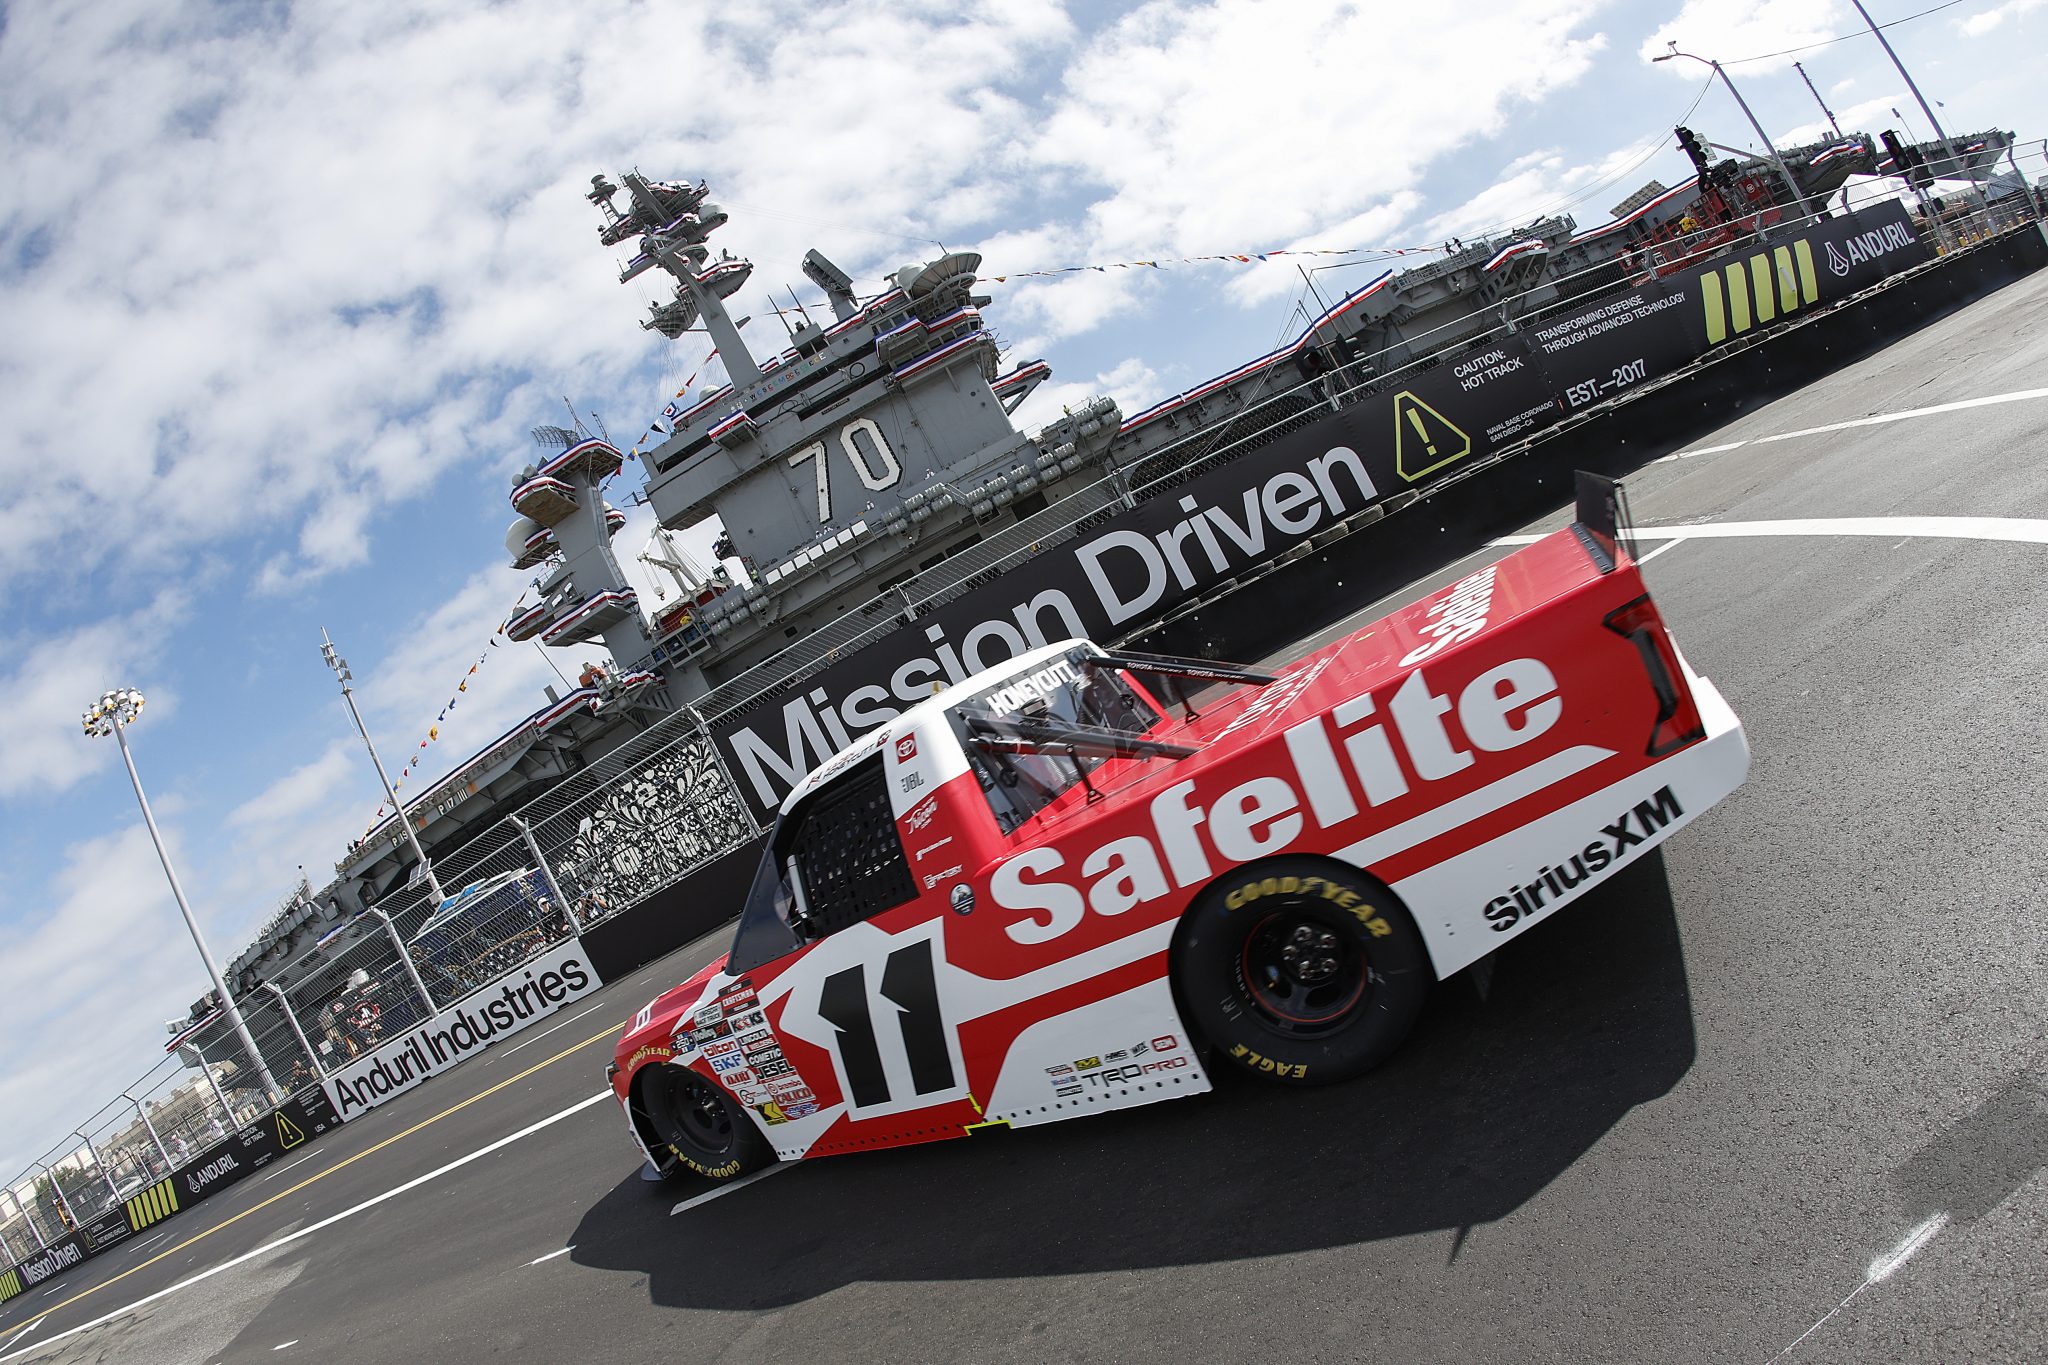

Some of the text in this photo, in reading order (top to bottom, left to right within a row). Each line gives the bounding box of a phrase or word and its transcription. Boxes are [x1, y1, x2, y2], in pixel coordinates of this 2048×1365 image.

[1846, 221, 1916, 266] ANDURIL
[1535, 294, 1644, 342] TRANSFORMING DEFENSE
[1542, 291, 1686, 354] THROUGH ADVANCED TECHNOLOGY
[1453, 349, 1506, 378] CAUTION:
[1460, 356, 1524, 392] HOT TRACK
[1486, 400, 1554, 436] NAVAL BASE CORONADO
[1489, 431, 1504, 443] SAN
[788, 418, 903, 524] 70
[727, 445, 1379, 809] Mission Driven
[1126, 661, 1152, 671] TOYOTA
[1186, 669, 1214, 678] TOYOTA
[985, 659, 1078, 718] HONEYCUTT
[900, 770, 924, 794] JBL
[988, 657, 1562, 945] Safelite
[1484, 784, 1684, 932] SiriusXM
[1225, 876, 1392, 938] GOODYEAR
[335, 958, 589, 1115] Anduril Industries
[692, 1028, 717, 1042] Holley
[740, 1030, 768, 1045] LINCOLN
[818, 938, 957, 1109] 11
[627, 1044, 671, 1072] GOODYEAR
[703, 1041, 738, 1057] tilton
[712, 1053, 742, 1073] SKF
[749, 1048, 782, 1066] COMETIC
[1230, 1043, 1308, 1079] EAGLE
[756, 1059, 795, 1080] JESEL
[1081, 1064, 1142, 1088] TRD
[1142, 1056, 1187, 1075] PRO
[314, 1123, 326, 1133] USA
[197, 1153, 239, 1187] ANDURIL
[668, 1143, 741, 1177] GOODYEAR
[20, 1241, 83, 1286] Mission Driven
